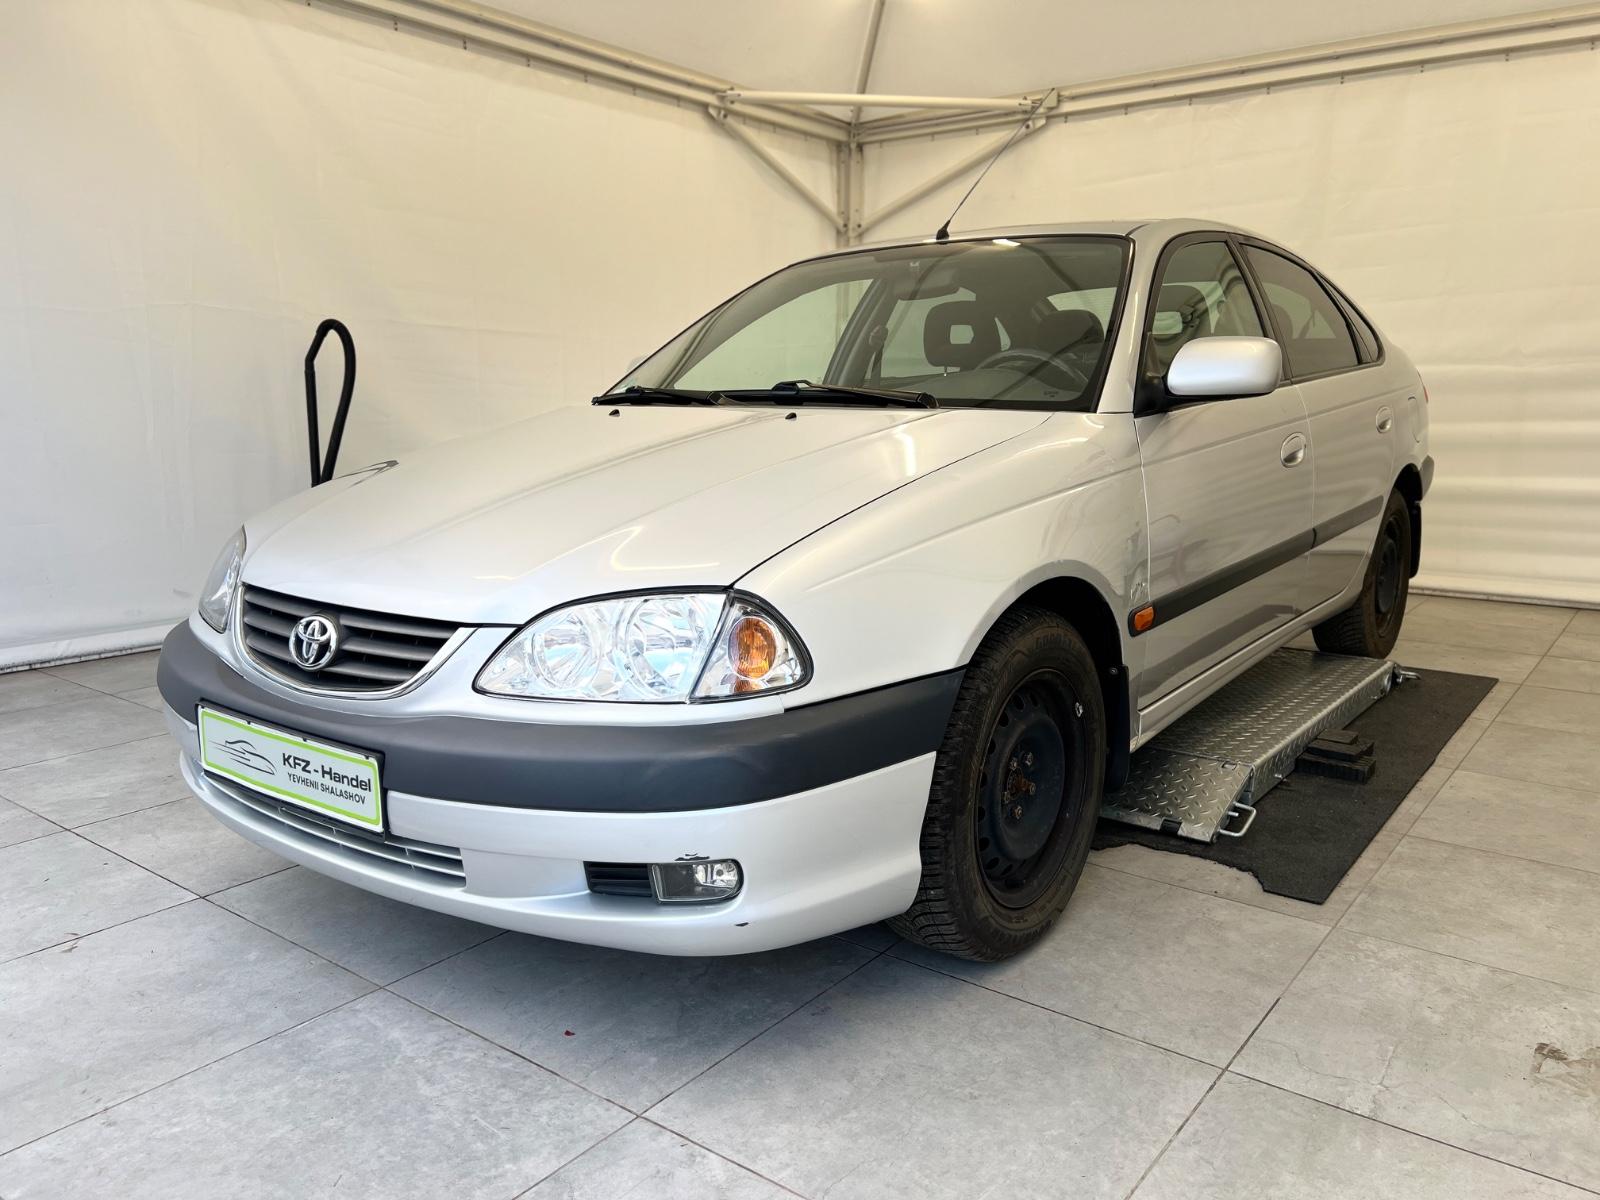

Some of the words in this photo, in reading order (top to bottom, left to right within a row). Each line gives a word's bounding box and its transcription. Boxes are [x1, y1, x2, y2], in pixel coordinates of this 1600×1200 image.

[282, 752, 312, 774] KFZ
[321, 764, 372, 792] Handel
[287, 772, 319, 790] YEVHENII
[320, 782, 366, 804] SHALASHOV
